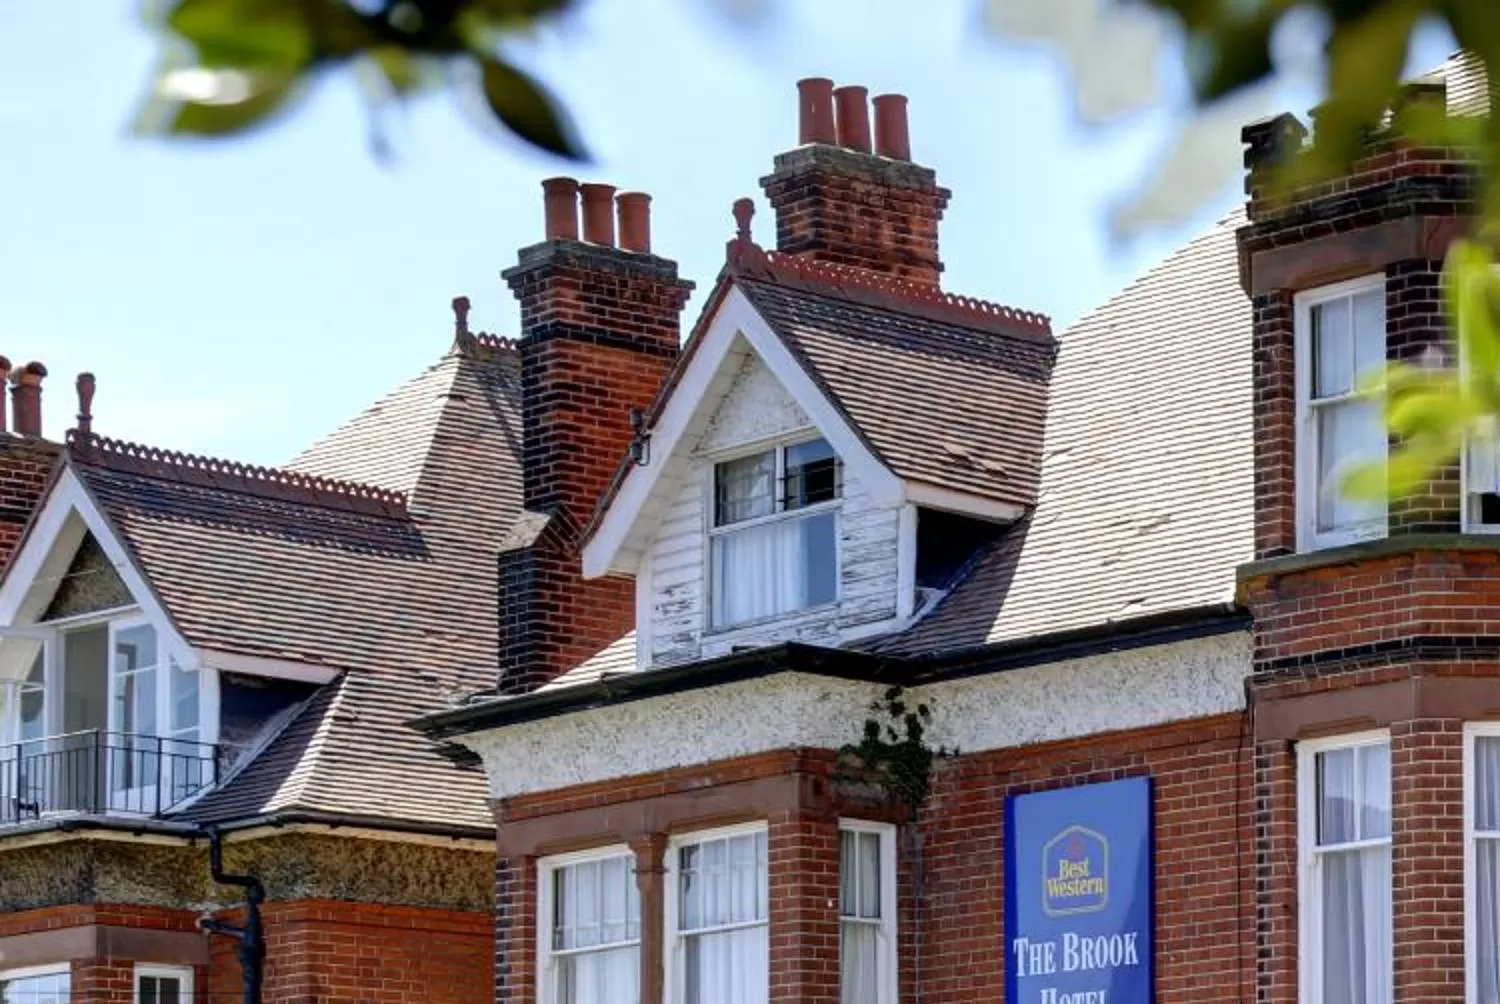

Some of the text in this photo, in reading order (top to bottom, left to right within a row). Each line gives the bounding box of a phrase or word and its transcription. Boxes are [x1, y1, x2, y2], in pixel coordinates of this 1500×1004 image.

[1047, 876, 1104, 899] Western
[1013, 932, 1139, 978] THE BROOK
